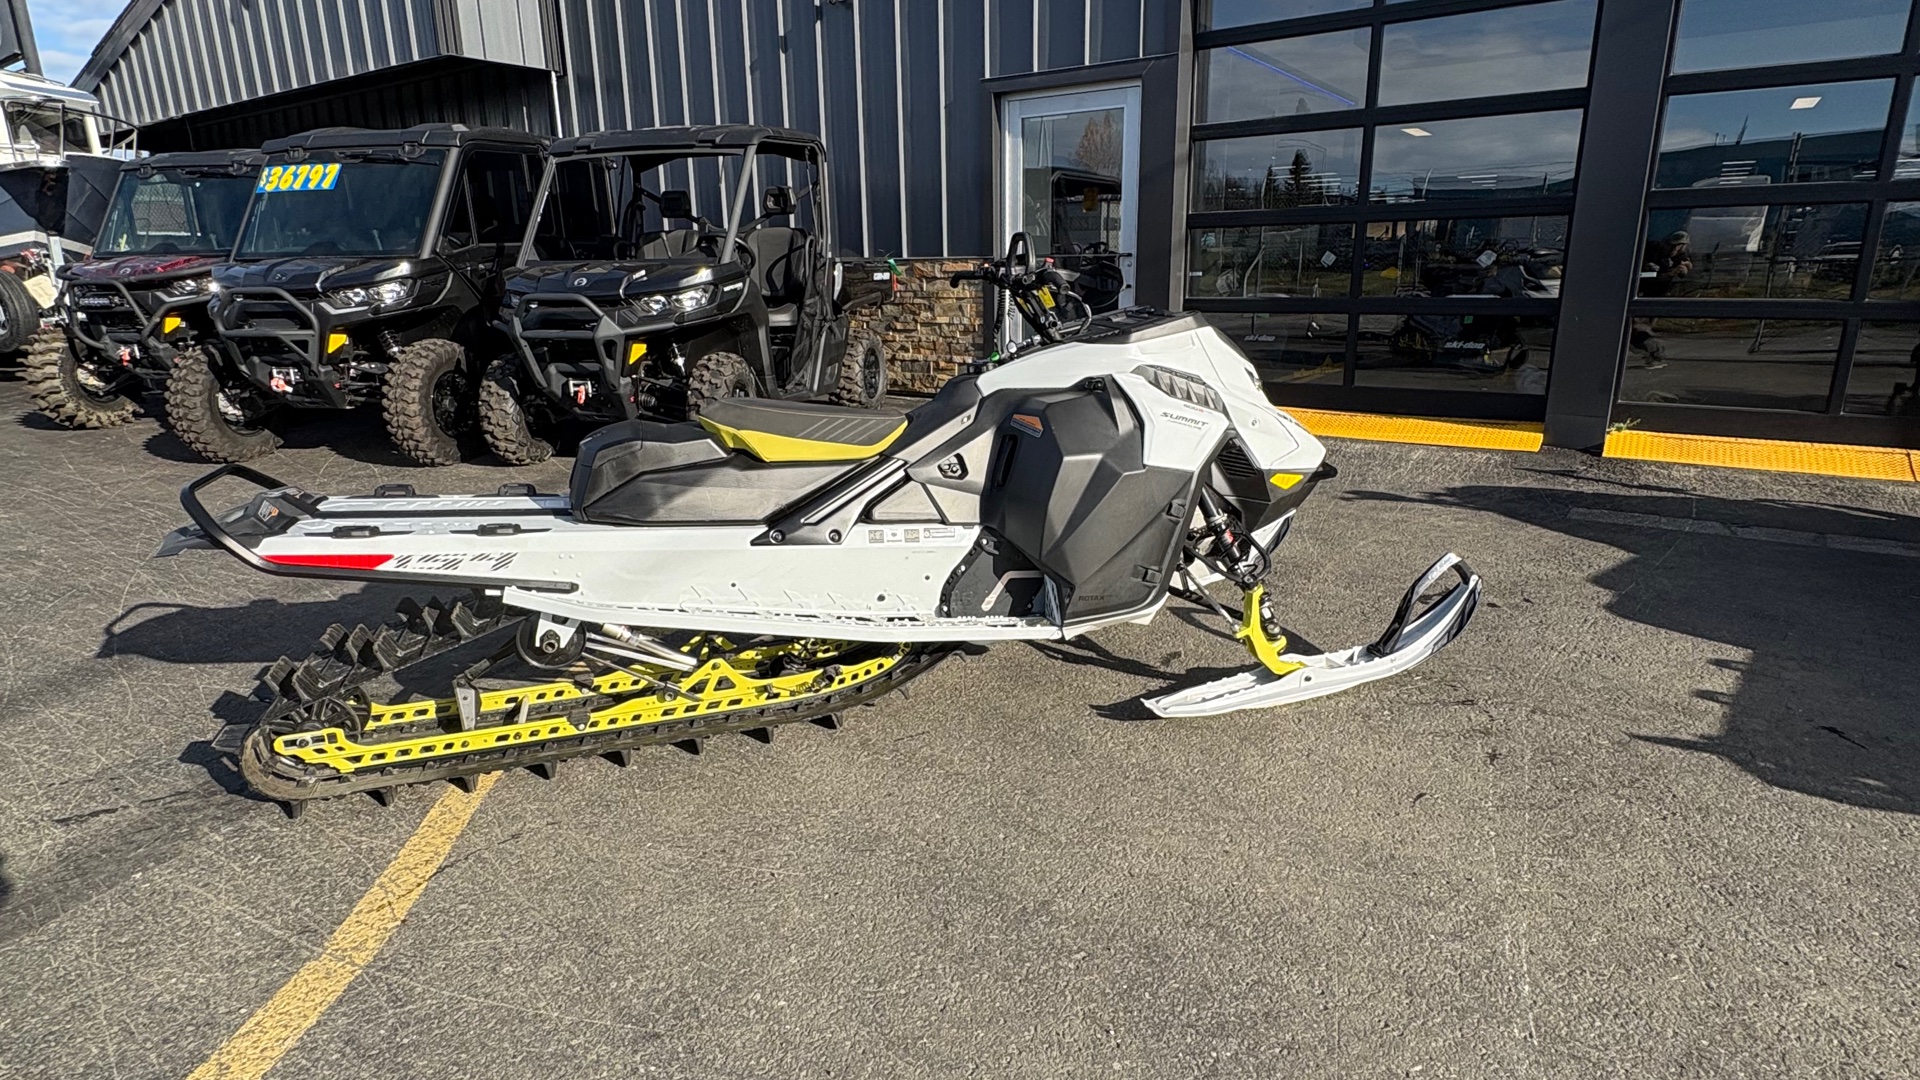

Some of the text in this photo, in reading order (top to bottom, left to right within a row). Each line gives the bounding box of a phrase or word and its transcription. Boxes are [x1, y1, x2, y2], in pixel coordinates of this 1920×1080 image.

[260, 163, 340, 192] $36797
[1443, 340, 1486, 349] ski-doo
[1160, 411, 1209, 427] SUMMIT
